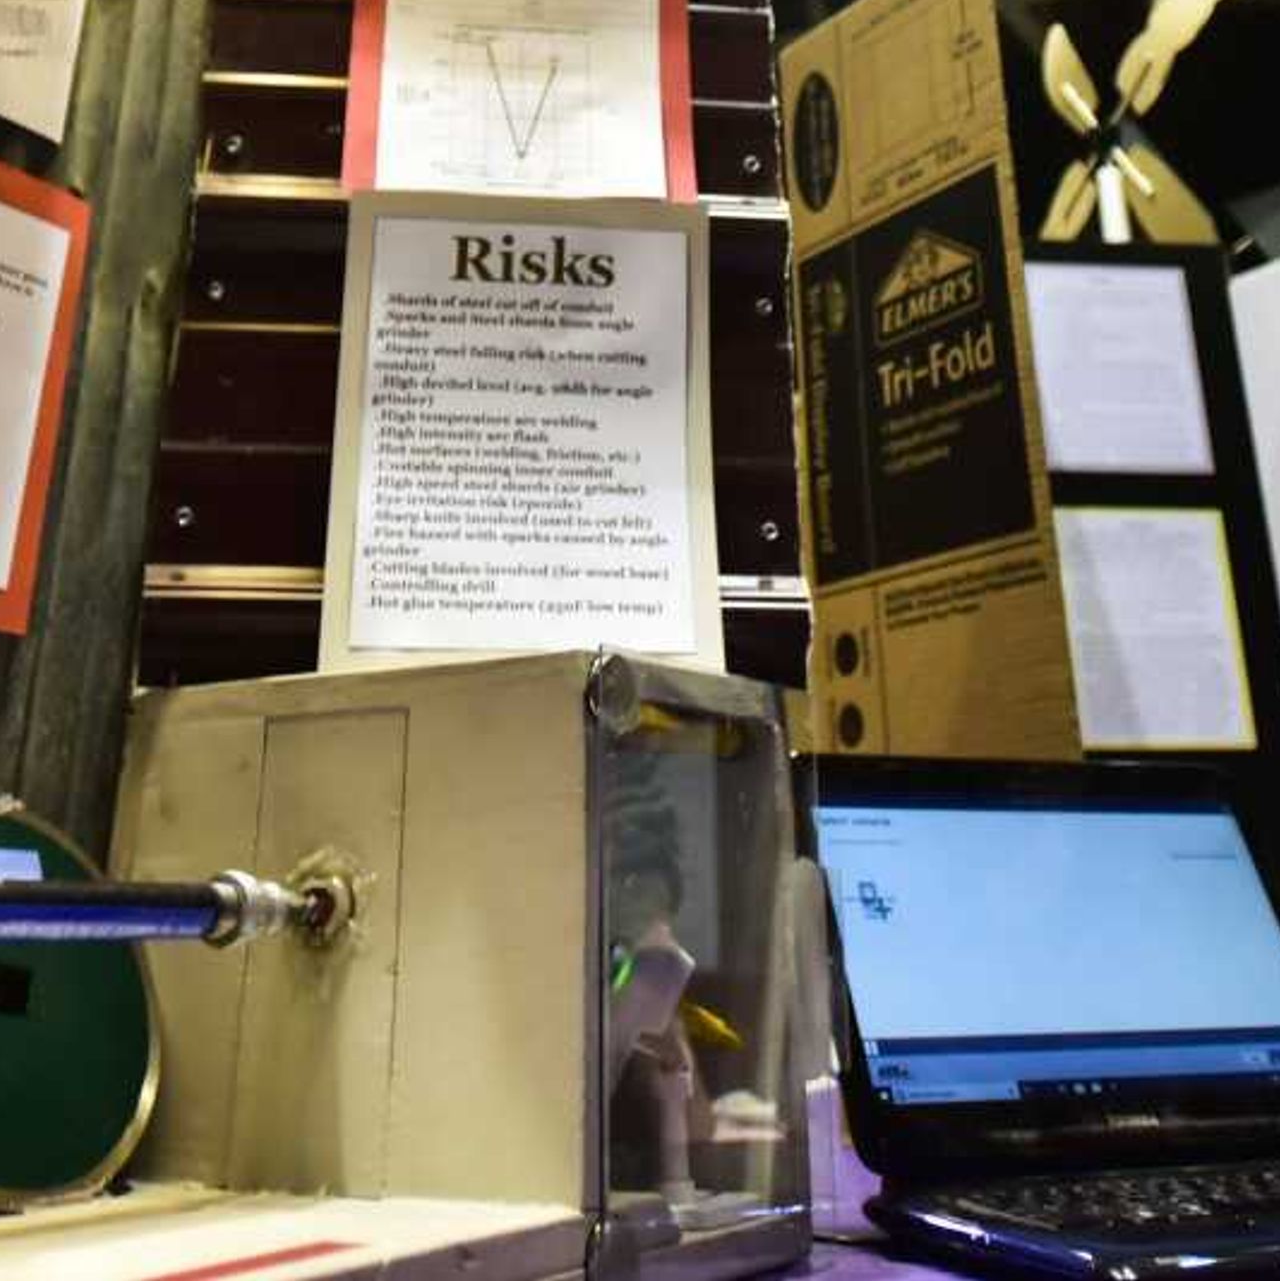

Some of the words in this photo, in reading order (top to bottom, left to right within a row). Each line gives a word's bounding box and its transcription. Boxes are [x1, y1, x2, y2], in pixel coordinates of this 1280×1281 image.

[449, 235, 614, 288] Risks
[441, 295, 455, 307] of
[881, 269, 975, 333] ELMER'S
[440, 312, 466, 324] and
[598, 318, 634, 333] angle
[376, 325, 429, 340] grinder
[433, 345, 466, 358] steel
[469, 345, 515, 361] falling
[518, 347, 545, 360] risk
[597, 351, 647, 366] cutting
[877, 322, 997, 408] Tri-Fold
[616, 384, 654, 400] angle
[542, 414, 597, 431] welding
[419, 428, 482, 444] intensity
[513, 430, 549, 444] flash
[410, 445, 471, 458] surfaces
[447, 462, 512, 479] spinning
[515, 465, 553, 478] inner
[558, 466, 614, 480] conduit
[406, 494, 477, 508] irritation
[480, 496, 509, 508] risk
[465, 512, 528, 526] involved
[409, 527, 461, 540] hazard
[629, 535, 669, 549] angle
[364, 543, 421, 558] grinder
[431, 562, 481, 576] blades
[485, 564, 548, 578] involved
[462, 579, 495, 593] drill
[439, 597, 534, 615] temperature
